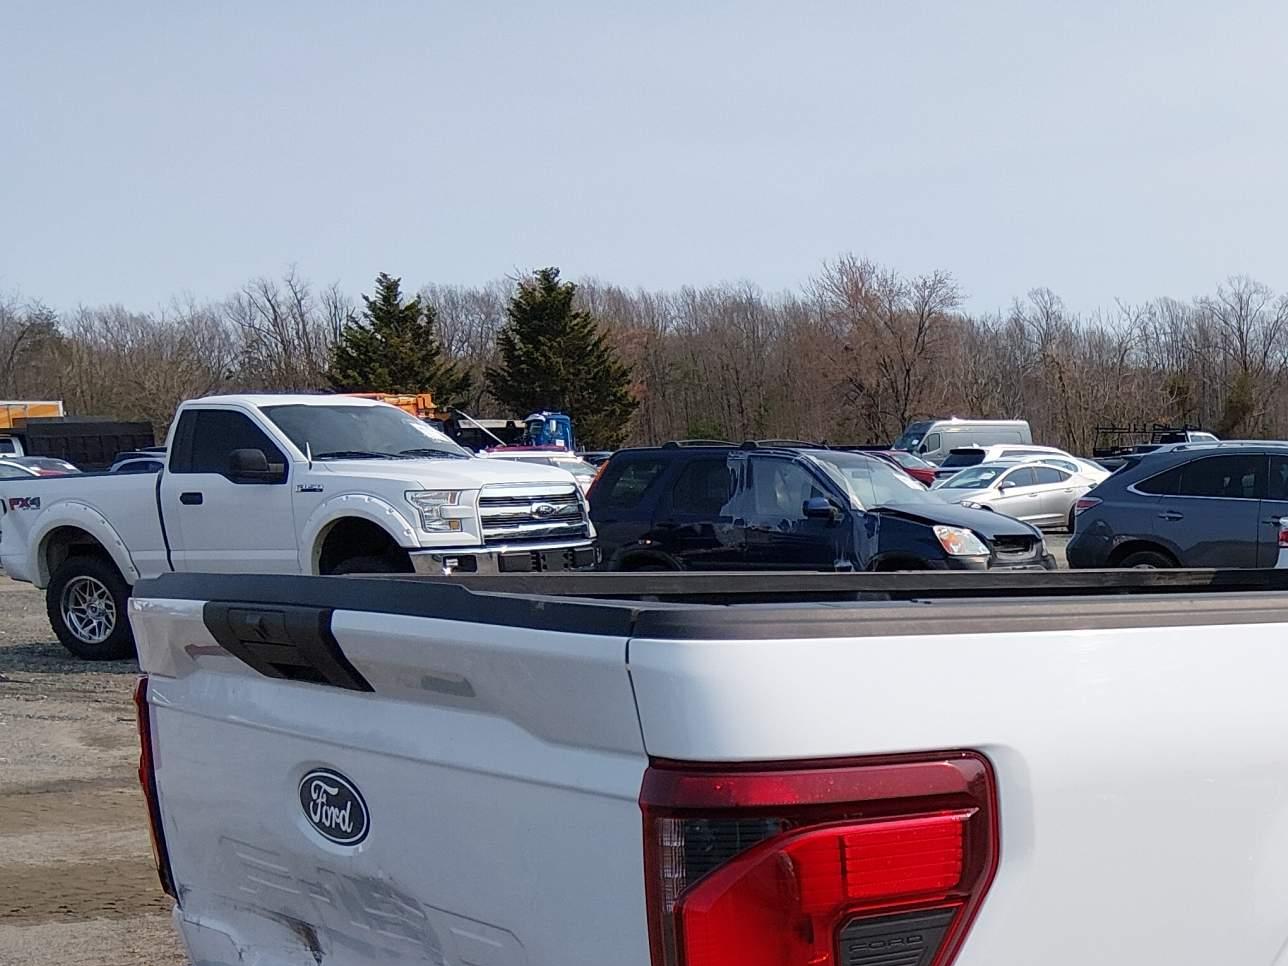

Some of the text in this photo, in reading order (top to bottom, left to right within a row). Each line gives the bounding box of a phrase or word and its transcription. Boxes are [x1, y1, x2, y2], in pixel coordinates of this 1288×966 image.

[8, 496, 41, 511] FX4
[309, 780, 354, 833] Ford
[848, 934, 924, 953] FORD
